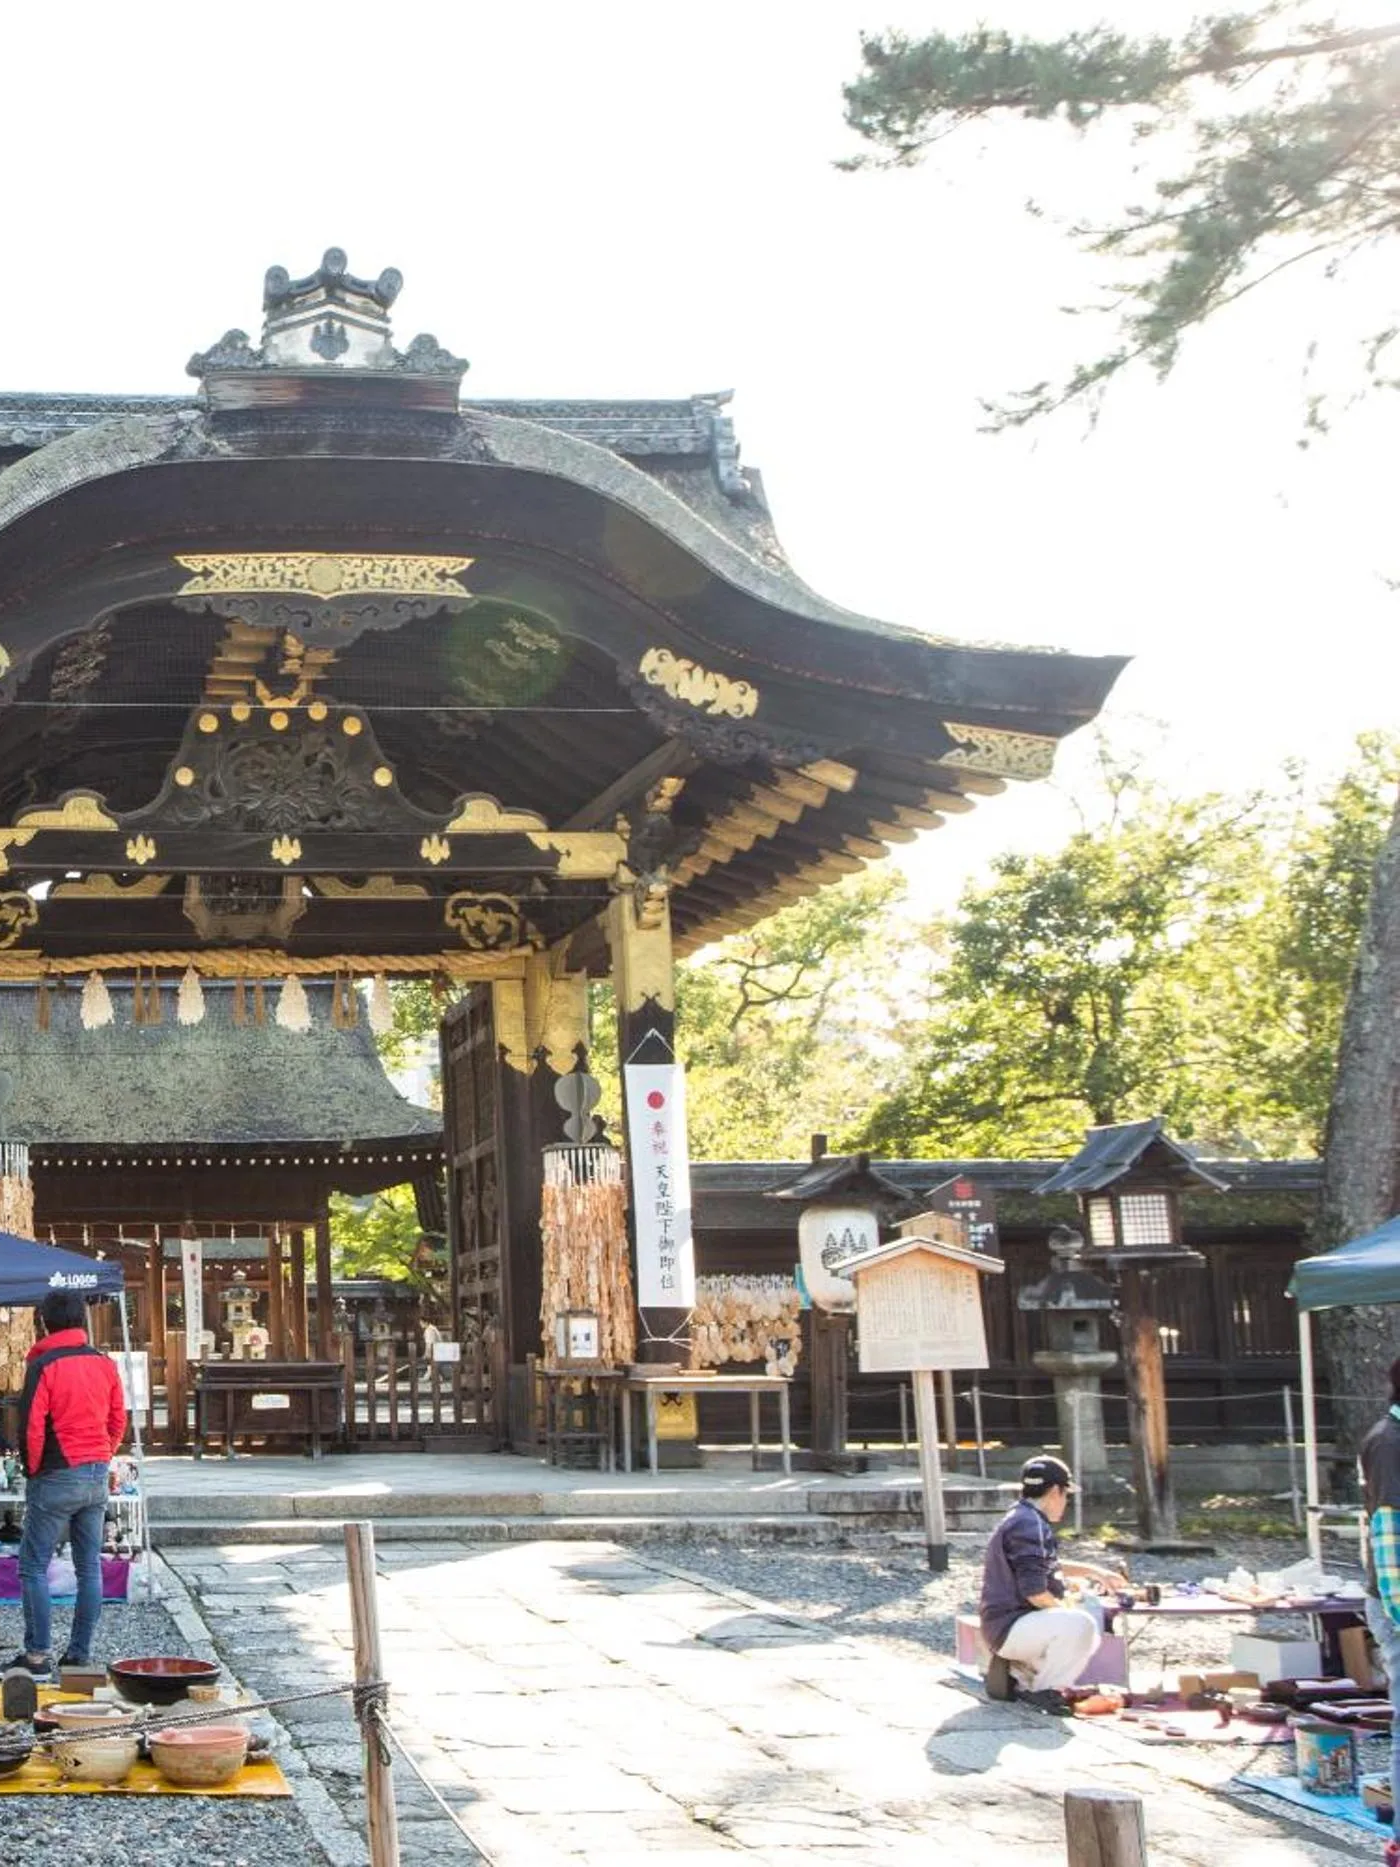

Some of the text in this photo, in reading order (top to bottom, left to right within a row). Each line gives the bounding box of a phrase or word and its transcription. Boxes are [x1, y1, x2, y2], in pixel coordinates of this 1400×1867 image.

[651, 1120, 675, 1289] 奉祝 天皇陛下御即位
